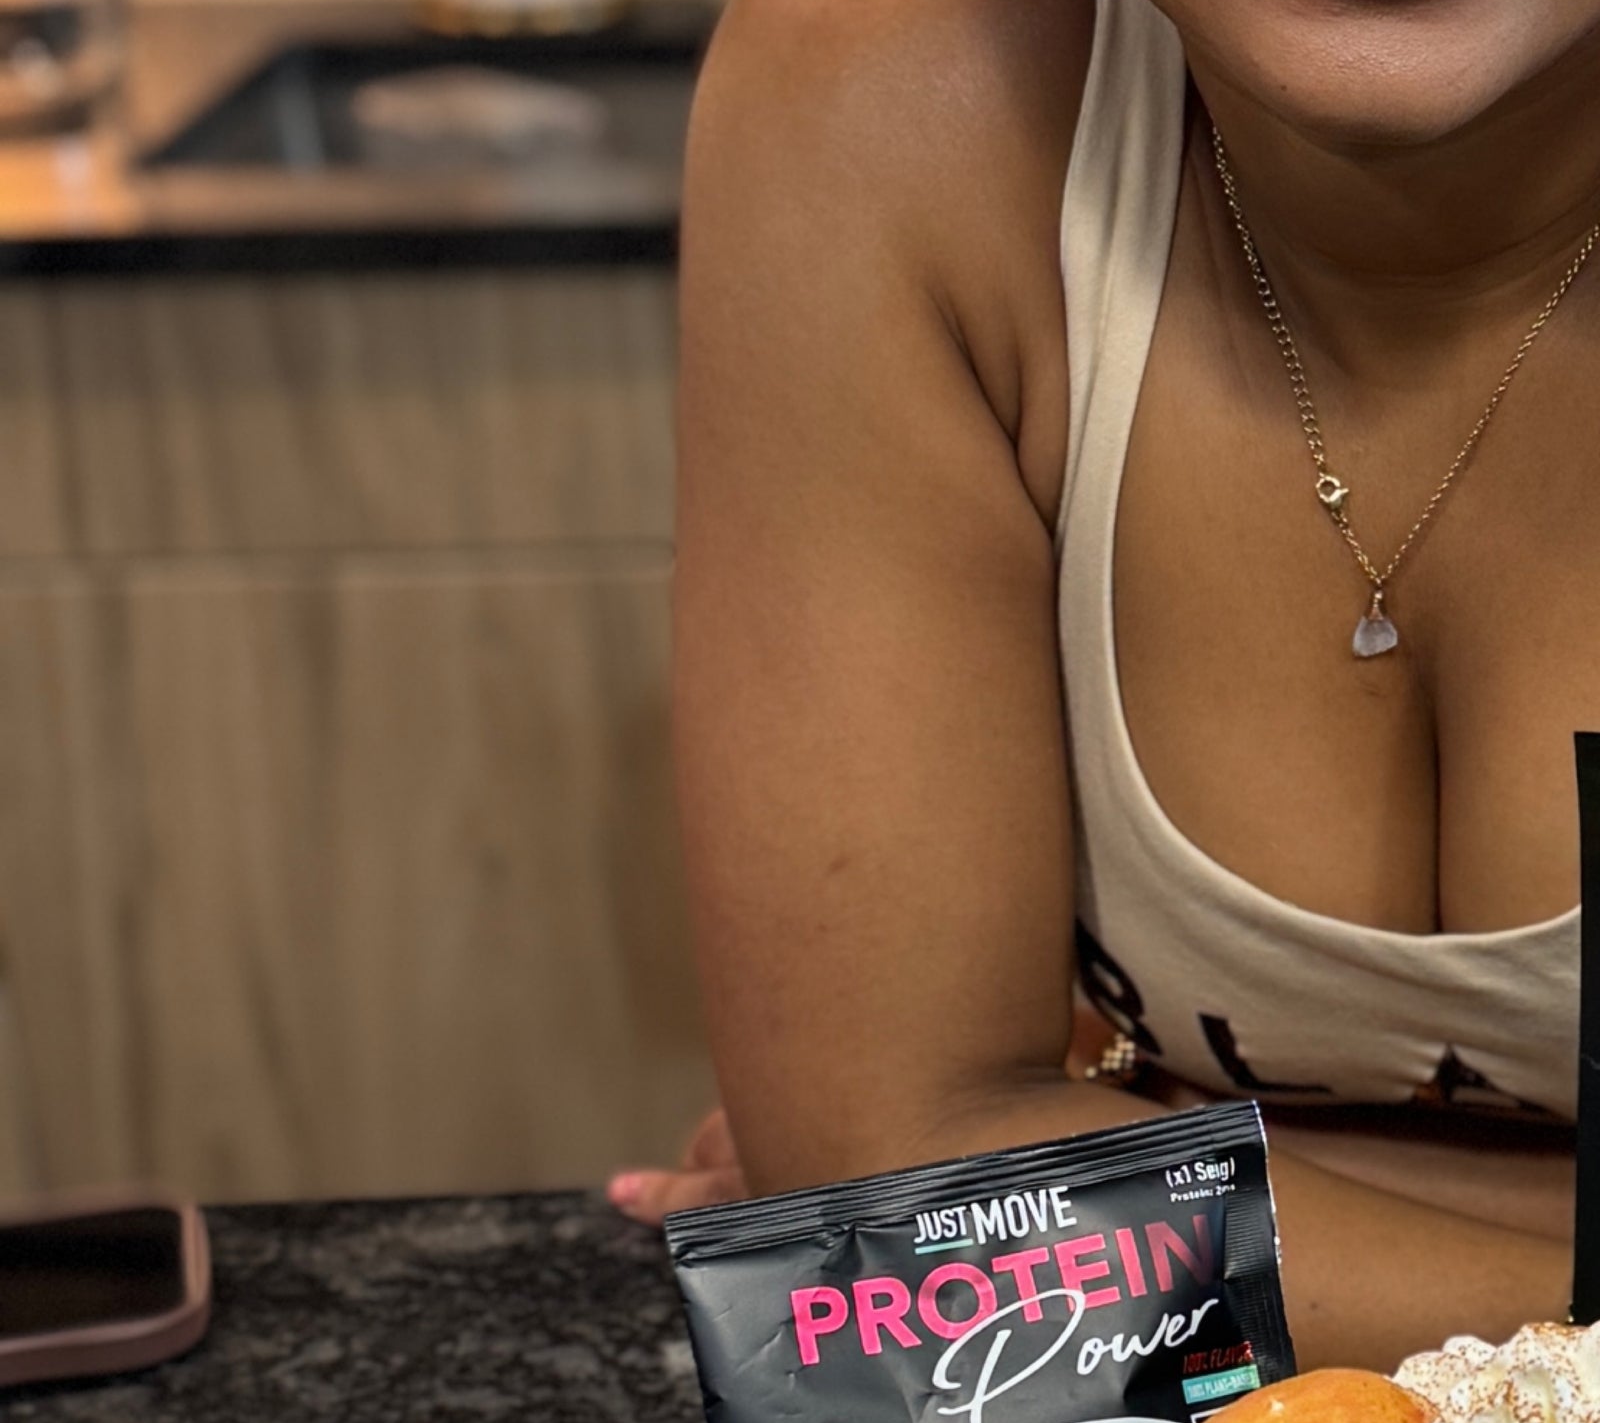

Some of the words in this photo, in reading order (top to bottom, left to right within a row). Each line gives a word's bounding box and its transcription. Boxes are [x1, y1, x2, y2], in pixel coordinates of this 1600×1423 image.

[913, 1205, 968, 1245] JUST
[971, 1185, 1077, 1245] MOVE
[790, 1214, 1213, 1366] PROTEIN
